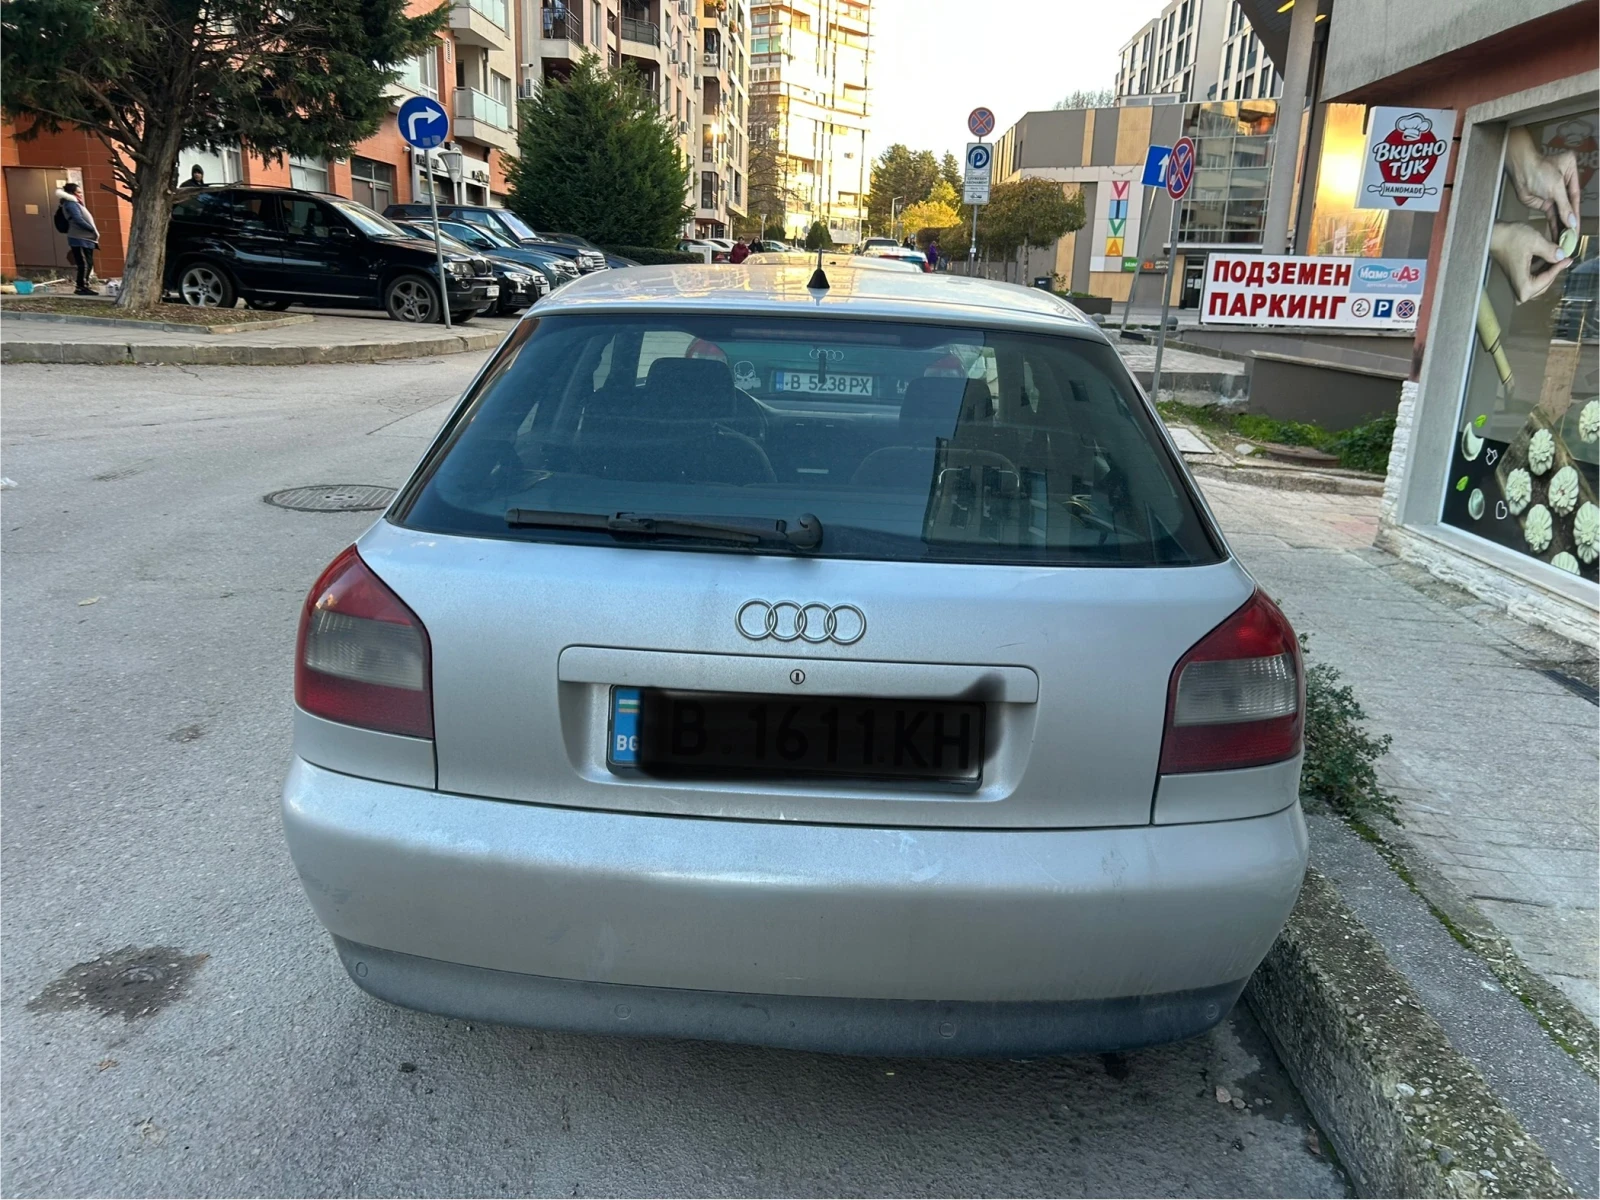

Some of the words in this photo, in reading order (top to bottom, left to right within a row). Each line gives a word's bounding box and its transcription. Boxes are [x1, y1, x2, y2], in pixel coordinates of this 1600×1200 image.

[1372, 140, 1446, 163] Вкусно
[1388, 158, 1430, 181] тук
[1384, 185, 1423, 195] HANDMADE
[1105, 181, 1130, 256] VIVA
[1212, 260, 1352, 288] ПОДЗЕМЕН
[1208, 292, 1347, 320] ПАРКИНГ
[790, 374, 800, 390] B
[808, 375, 847, 392] 5238
[850, 378, 870, 394] PX
